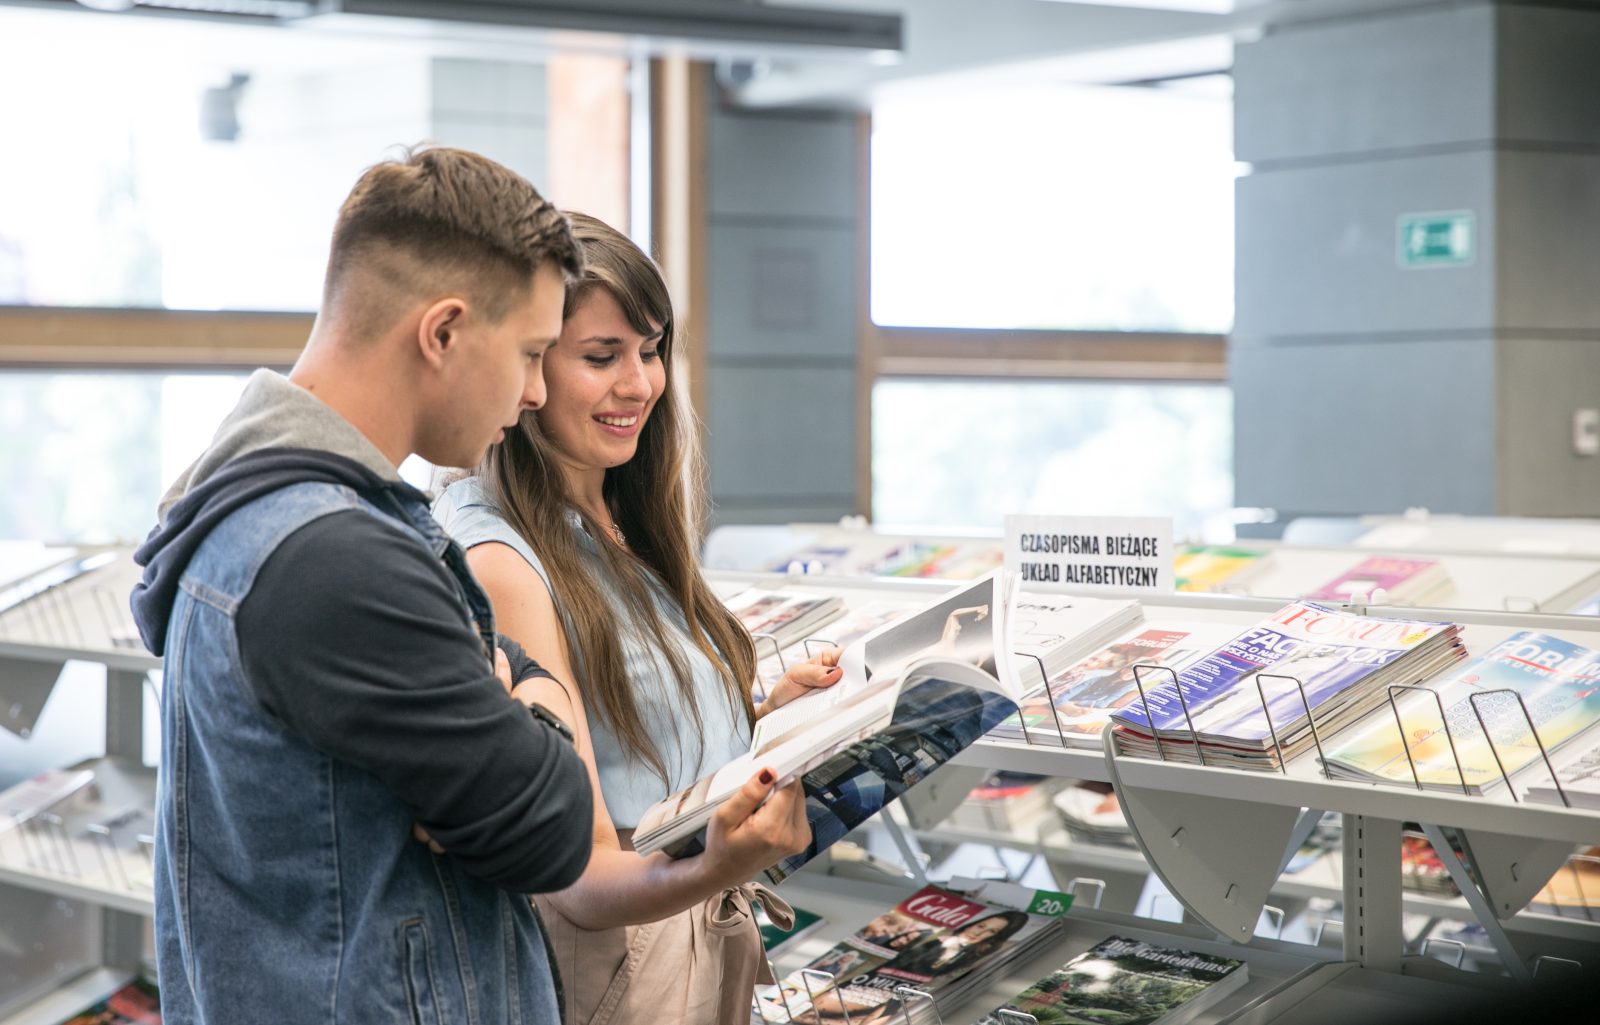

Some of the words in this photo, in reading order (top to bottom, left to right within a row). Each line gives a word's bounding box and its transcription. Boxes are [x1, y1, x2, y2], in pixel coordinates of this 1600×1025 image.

[1021, 533, 1099, 555] CZASOPISMA
[1106, 533, 1158, 560] BIEŻĄCE
[1021, 563, 1060, 583] UKŁAD
[1066, 564, 1158, 587] ALFABETYCZNY
[907, 893, 969, 926] Gala
[851, 974, 869, 985] O
